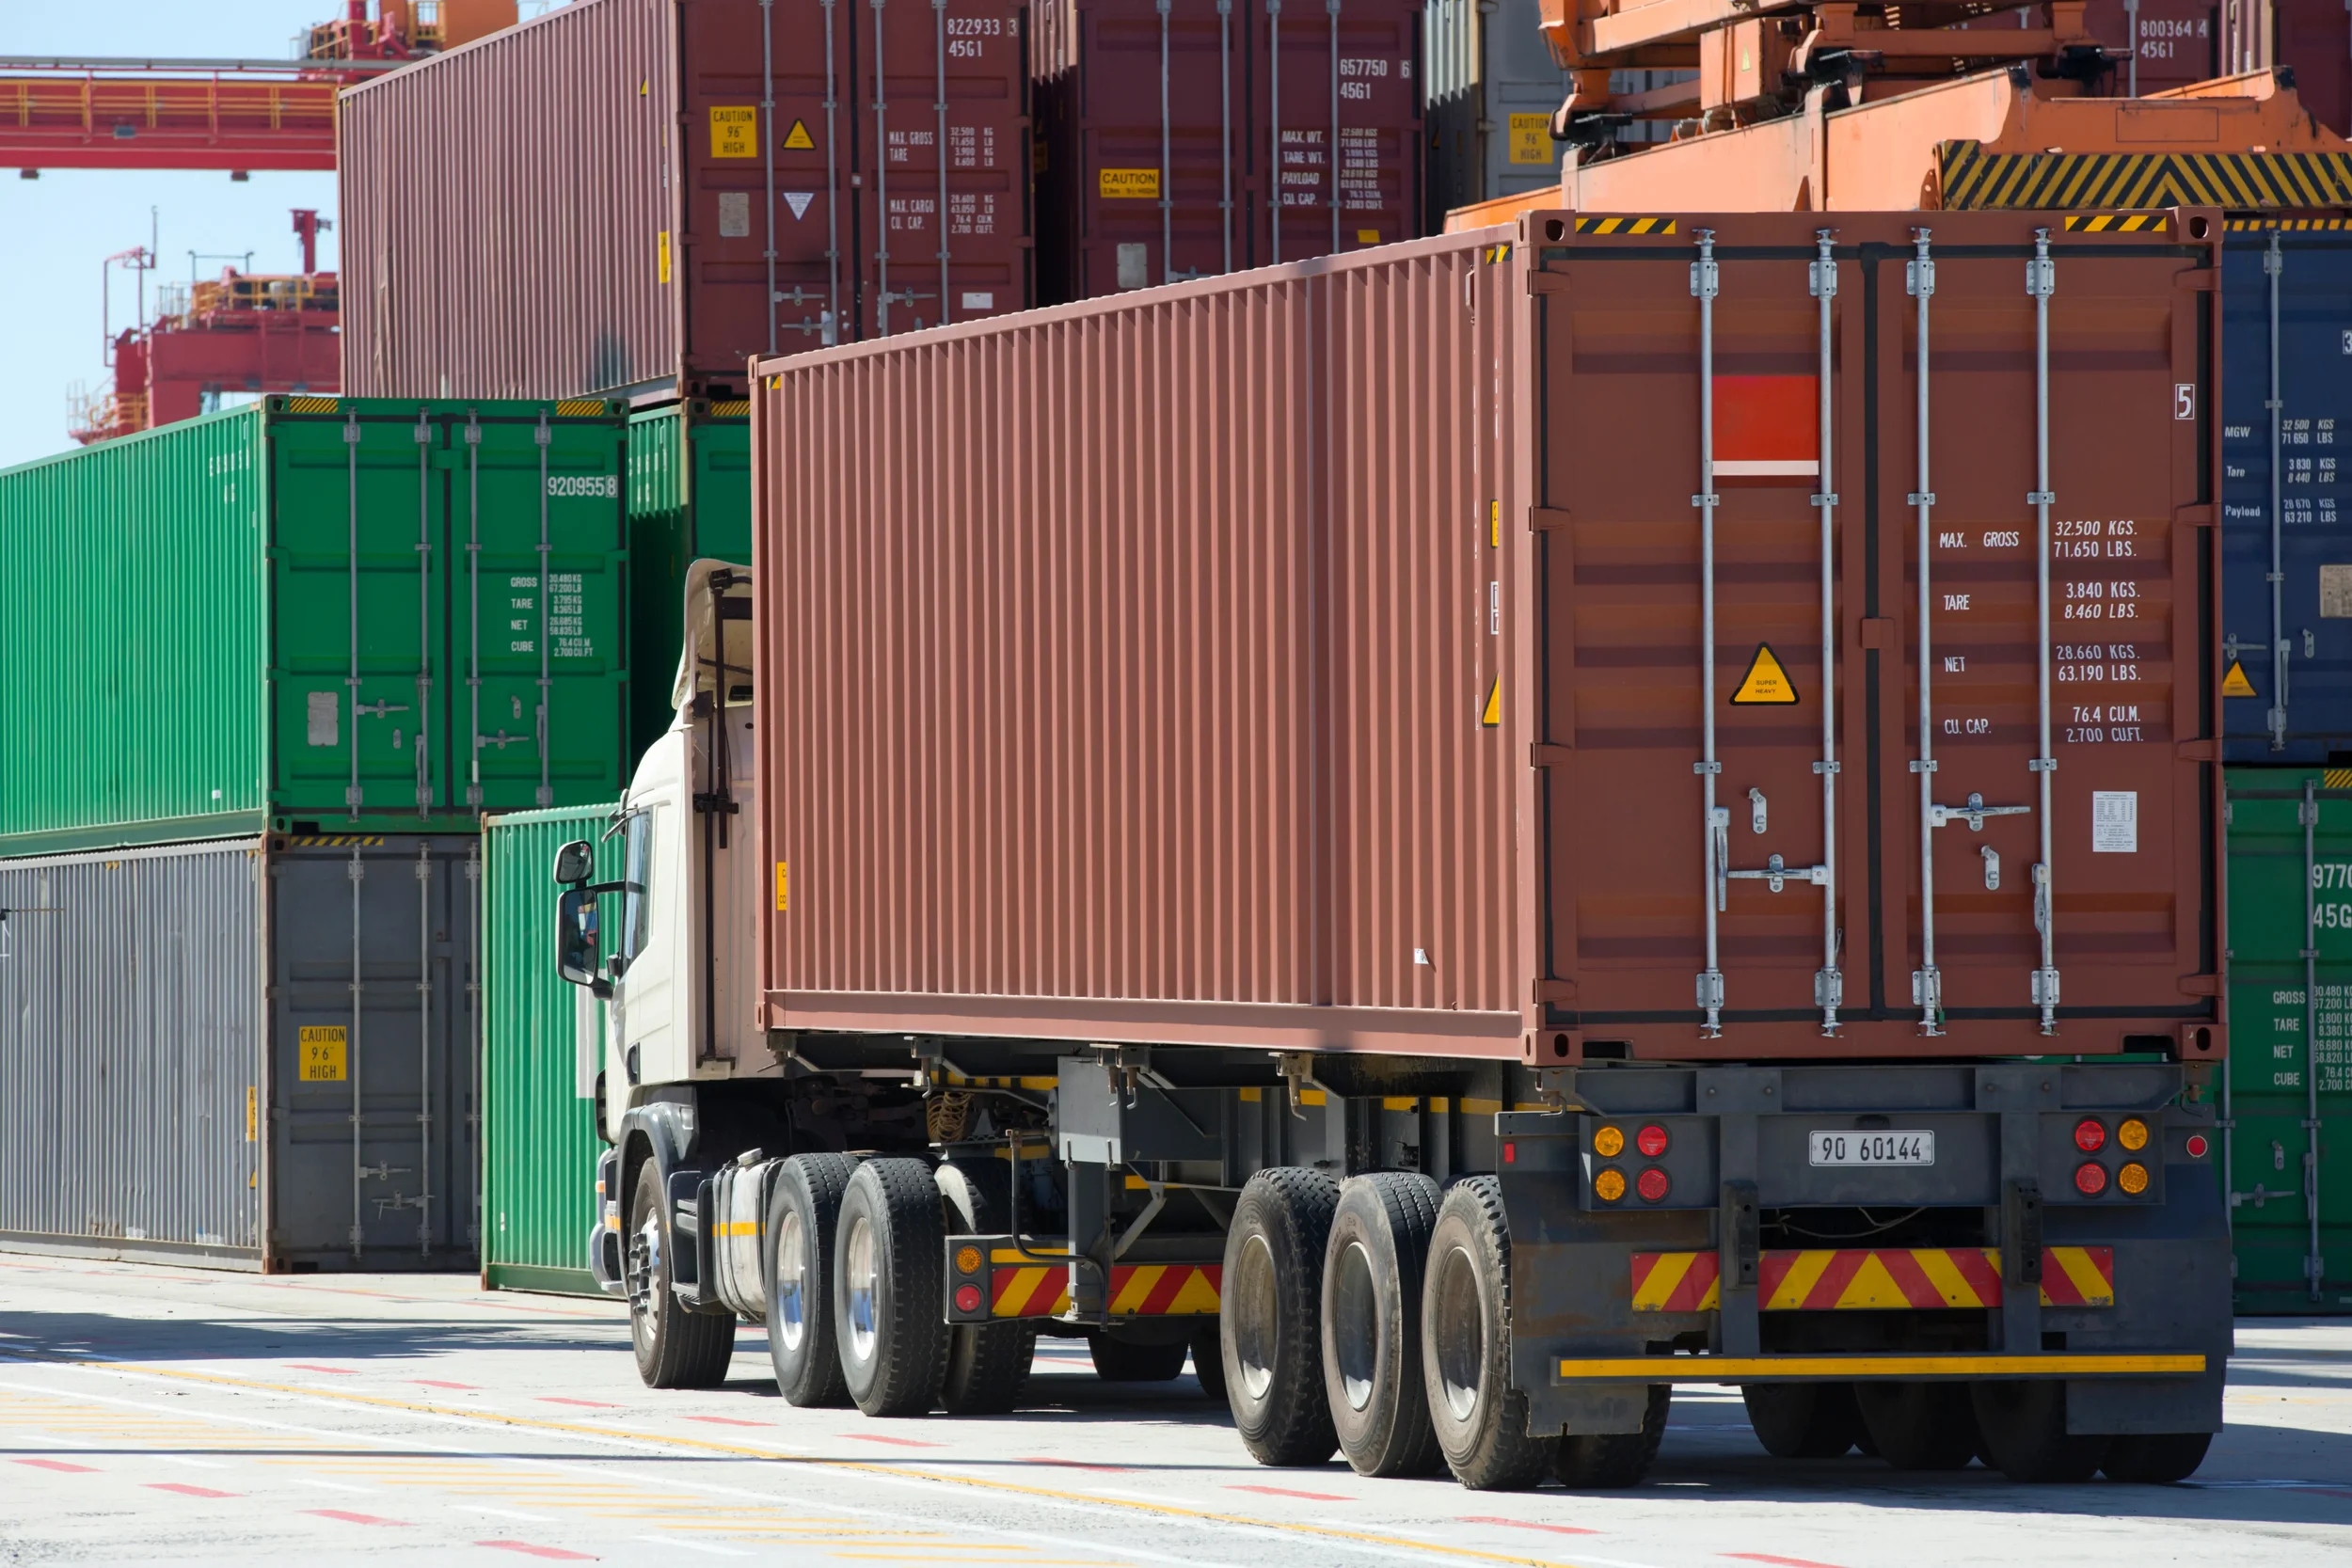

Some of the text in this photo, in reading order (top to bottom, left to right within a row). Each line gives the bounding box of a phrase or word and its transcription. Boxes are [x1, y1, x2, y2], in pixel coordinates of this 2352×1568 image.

[946, 18, 1018, 36] 822933 3
[2140, 19, 2208, 38] 800364 4
[948, 40, 983, 57] 45G1
[2140, 41, 2175, 58] 45G1
[1340, 58, 1410, 79] 657750 6
[1340, 82, 1372, 100] 45G1
[713, 111, 753, 122] CAUTION
[1512, 117, 1550, 129] CAUTION
[889, 132, 933, 145] MAX. GROSS
[1307, 131, 1325, 143] WT.
[723, 142, 745, 153] HIGH
[1520, 149, 1542, 160] HIGH
[889, 148, 908, 162] TARE
[1283, 151, 1326, 164] TARE WT.
[1102, 173, 1156, 184] CAUTION
[1281, 172, 1320, 184] PAYLOAD
[890, 199, 934, 213] MAX. CARGO
[1298, 193, 1318, 205] CAP.
[908, 216, 924, 230] CAP.
[2178, 387, 2192, 418] 5
[2317, 419, 2334, 430] KGS
[2225, 426, 2251, 438] MGW
[2317, 432, 2333, 444] LBS
[2319, 457, 2336, 469] KGS
[2227, 465, 2246, 478] Tare
[2318, 471, 2335, 483] LBS
[2318, 498, 2335, 509] KGS
[2225, 505, 2261, 519] Payload
[2320, 511, 2337, 523] LBS
[2107, 520, 2138, 536] KGS.
[1939, 531, 2020, 548] MAX. GROSS
[2106, 541, 2137, 557] LBS.
[511, 577, 537, 588] GROSS
[2110, 581, 2140, 598] KGS.
[511, 598, 533, 610] TARE
[1944, 594, 1970, 610] TARE
[2109, 603, 2138, 619] LBS.
[511, 620, 528, 630] NET
[511, 641, 534, 653] CUBE
[2109, 644, 2140, 659] KGS.
[1945, 657, 1965, 673] NET
[2111, 664, 2141, 681] LBS.
[2073, 705, 2141, 722] 76.4 CU.M.
[1944, 719, 1992, 735] CU. CAP.
[2273, 990, 2306, 1005] GROSS
[2274, 1018, 2300, 1032] TARE
[301, 1028, 345, 1042] CAUTION
[2274, 1045, 2294, 1059] NET
[310, 1065, 337, 1079] HIGH
[2274, 1071, 2300, 1085] CUBE
[1822, 1137, 1921, 1161] 90 60144
